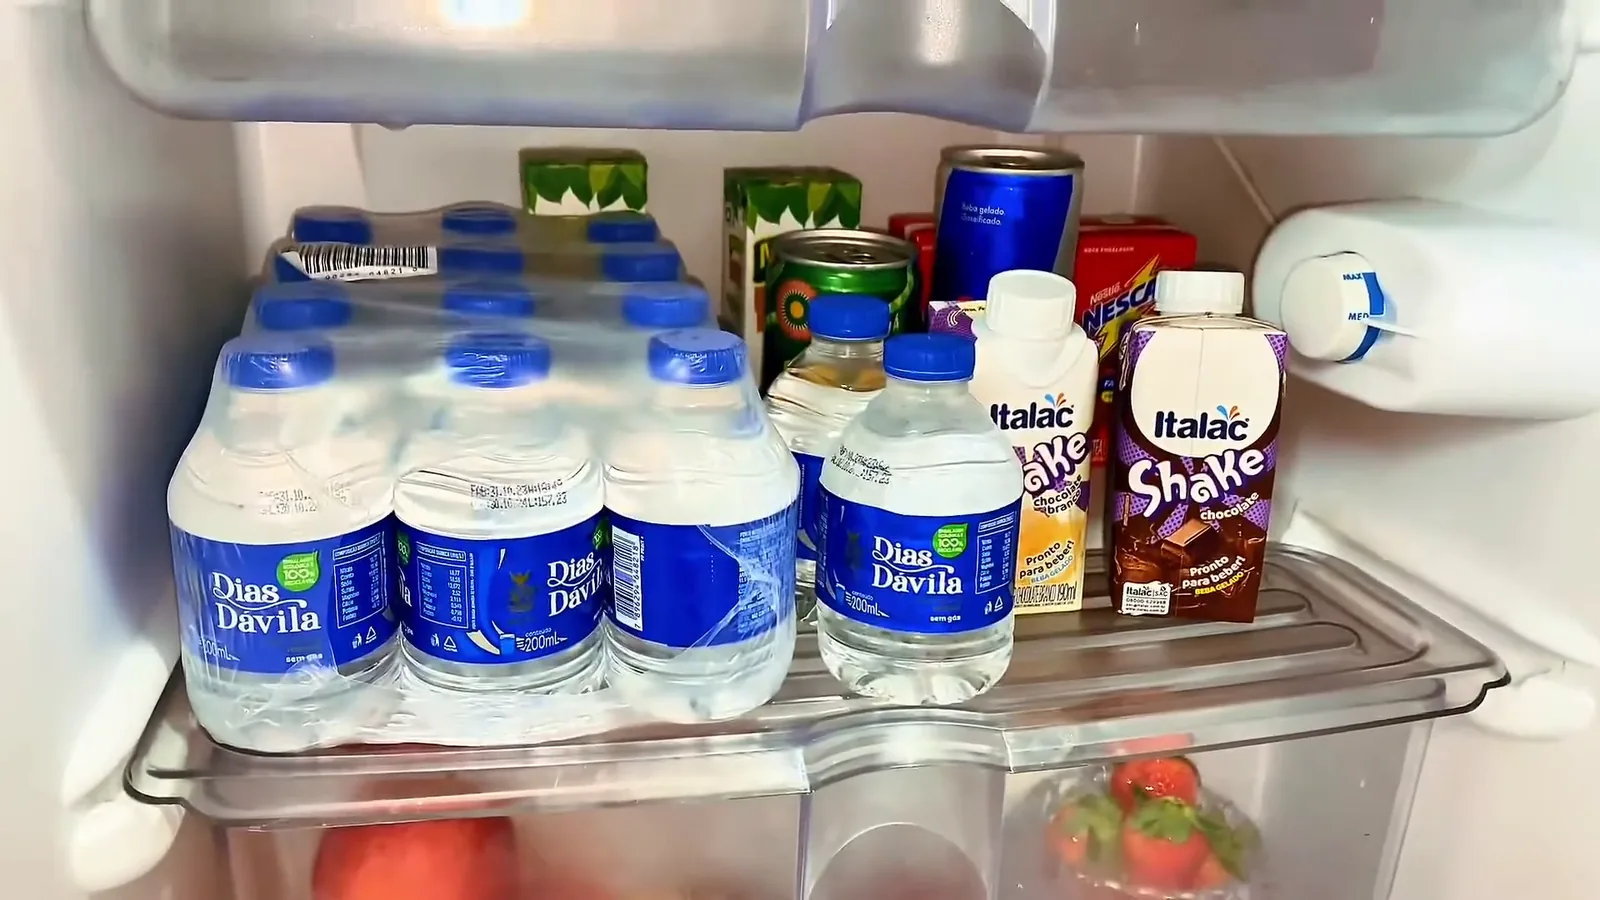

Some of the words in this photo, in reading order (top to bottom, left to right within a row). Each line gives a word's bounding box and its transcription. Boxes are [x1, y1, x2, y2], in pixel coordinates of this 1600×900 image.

[1343, 273, 1363, 281] MAX
[1082, 278, 1157, 334] NESCA
[990, 401, 1074, 431] Italac
[1154, 410, 1249, 441] Italac
[1024, 432, 1087, 493] ake
[1033, 474, 1082, 507] chocolate
[1128, 449, 1264, 517] Shake
[1047, 489, 1081, 514] branco
[1200, 492, 1259, 521] chocolate
[872, 536, 933, 568] Dias
[1026, 542, 1060, 566] Pronto
[1190, 556, 1229, 577] Pronto
[547, 552, 595, 587] Dias
[871, 562, 963, 596] Dávila
[1019, 565, 1044, 580] para
[1182, 577, 1210, 590] para
[1210, 555, 1246, 583] beber!
[1195, 586, 1217, 595] BEBA
[1215, 571, 1244, 591] GELADO
[212, 571, 280, 604] Dias
[548, 565, 602, 617] Dávil
[1126, 586, 1152, 597] Italac
[215, 602, 322, 634] Dávila
[852, 596, 880, 617] 200mL
[525, 631, 560, 652] 200mL
